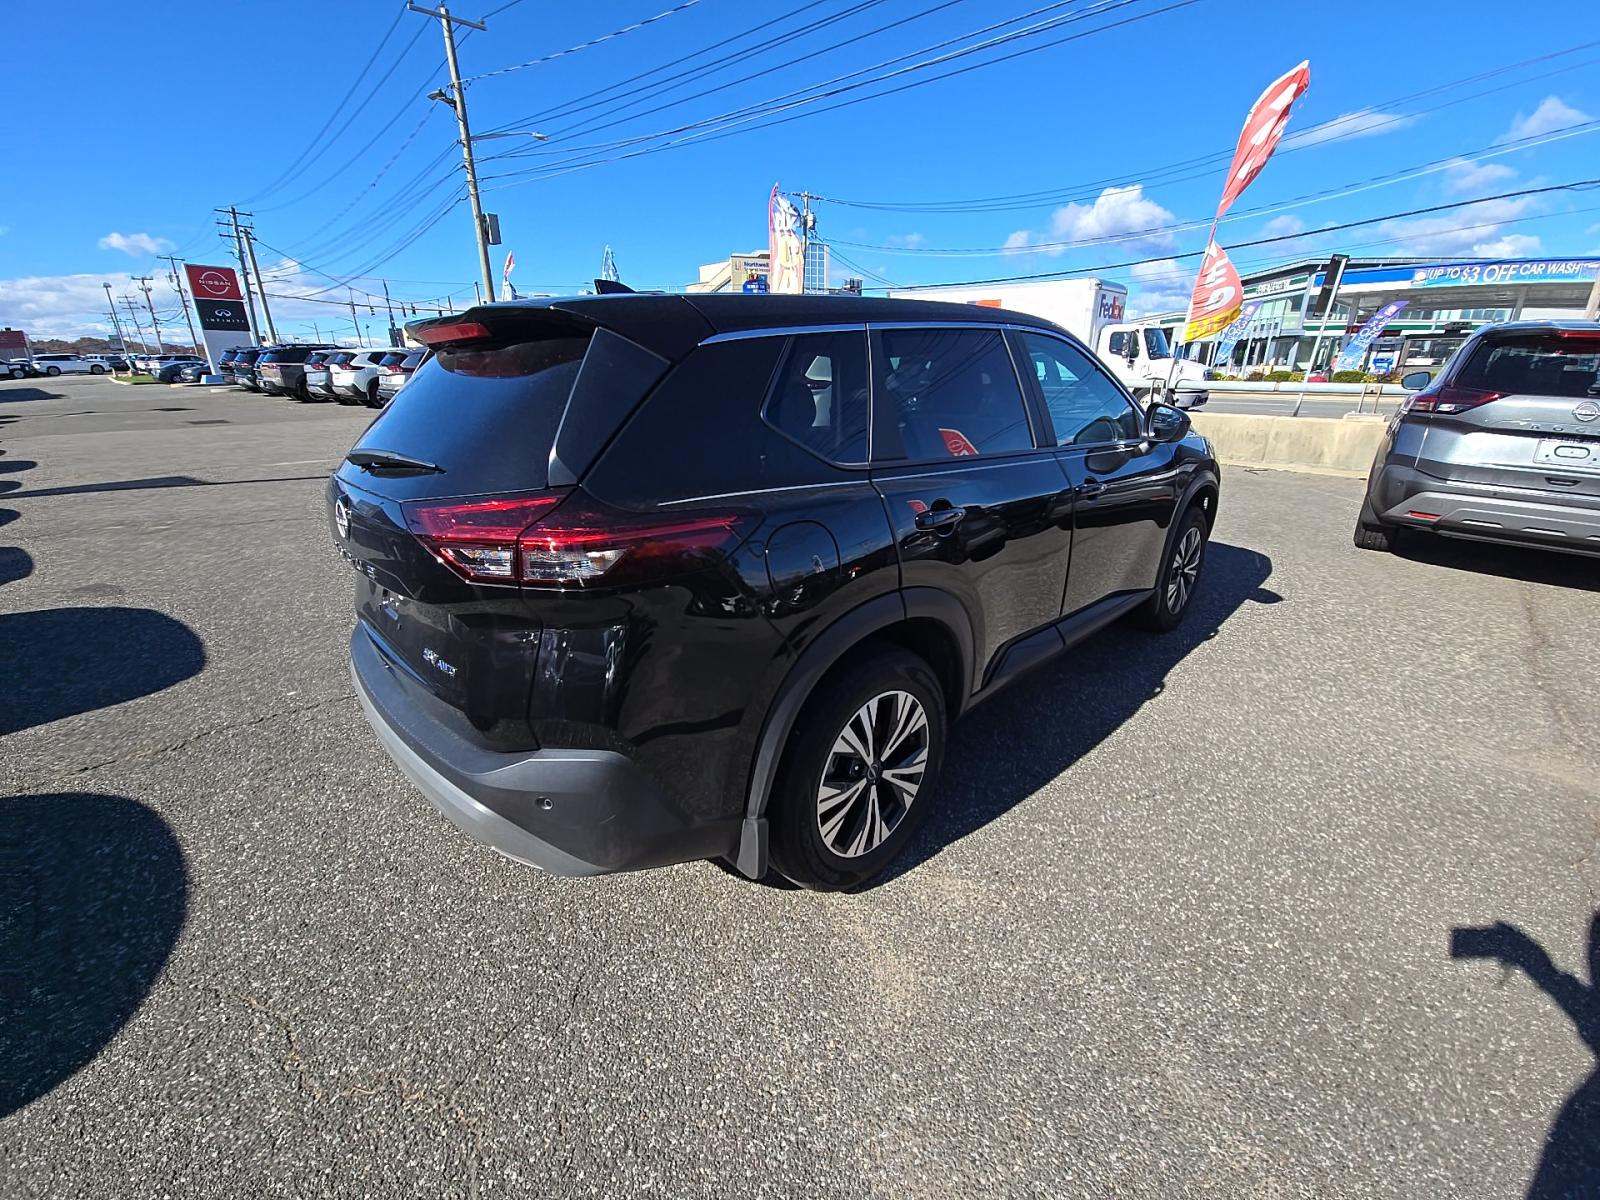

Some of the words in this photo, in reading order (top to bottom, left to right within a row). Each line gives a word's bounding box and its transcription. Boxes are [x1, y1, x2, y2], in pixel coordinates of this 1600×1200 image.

[1428, 268, 1443, 280] UP
[1444, 267, 1461, 279] TO
[1461, 266, 1480, 282] $3
[1483, 264, 1520, 281] OFF
[1520, 263, 1546, 275] CAR
[1546, 262, 1580, 274] WASH
[199, 279, 231, 287] NISSAN
[1099, 294, 1124, 320] FedEx
